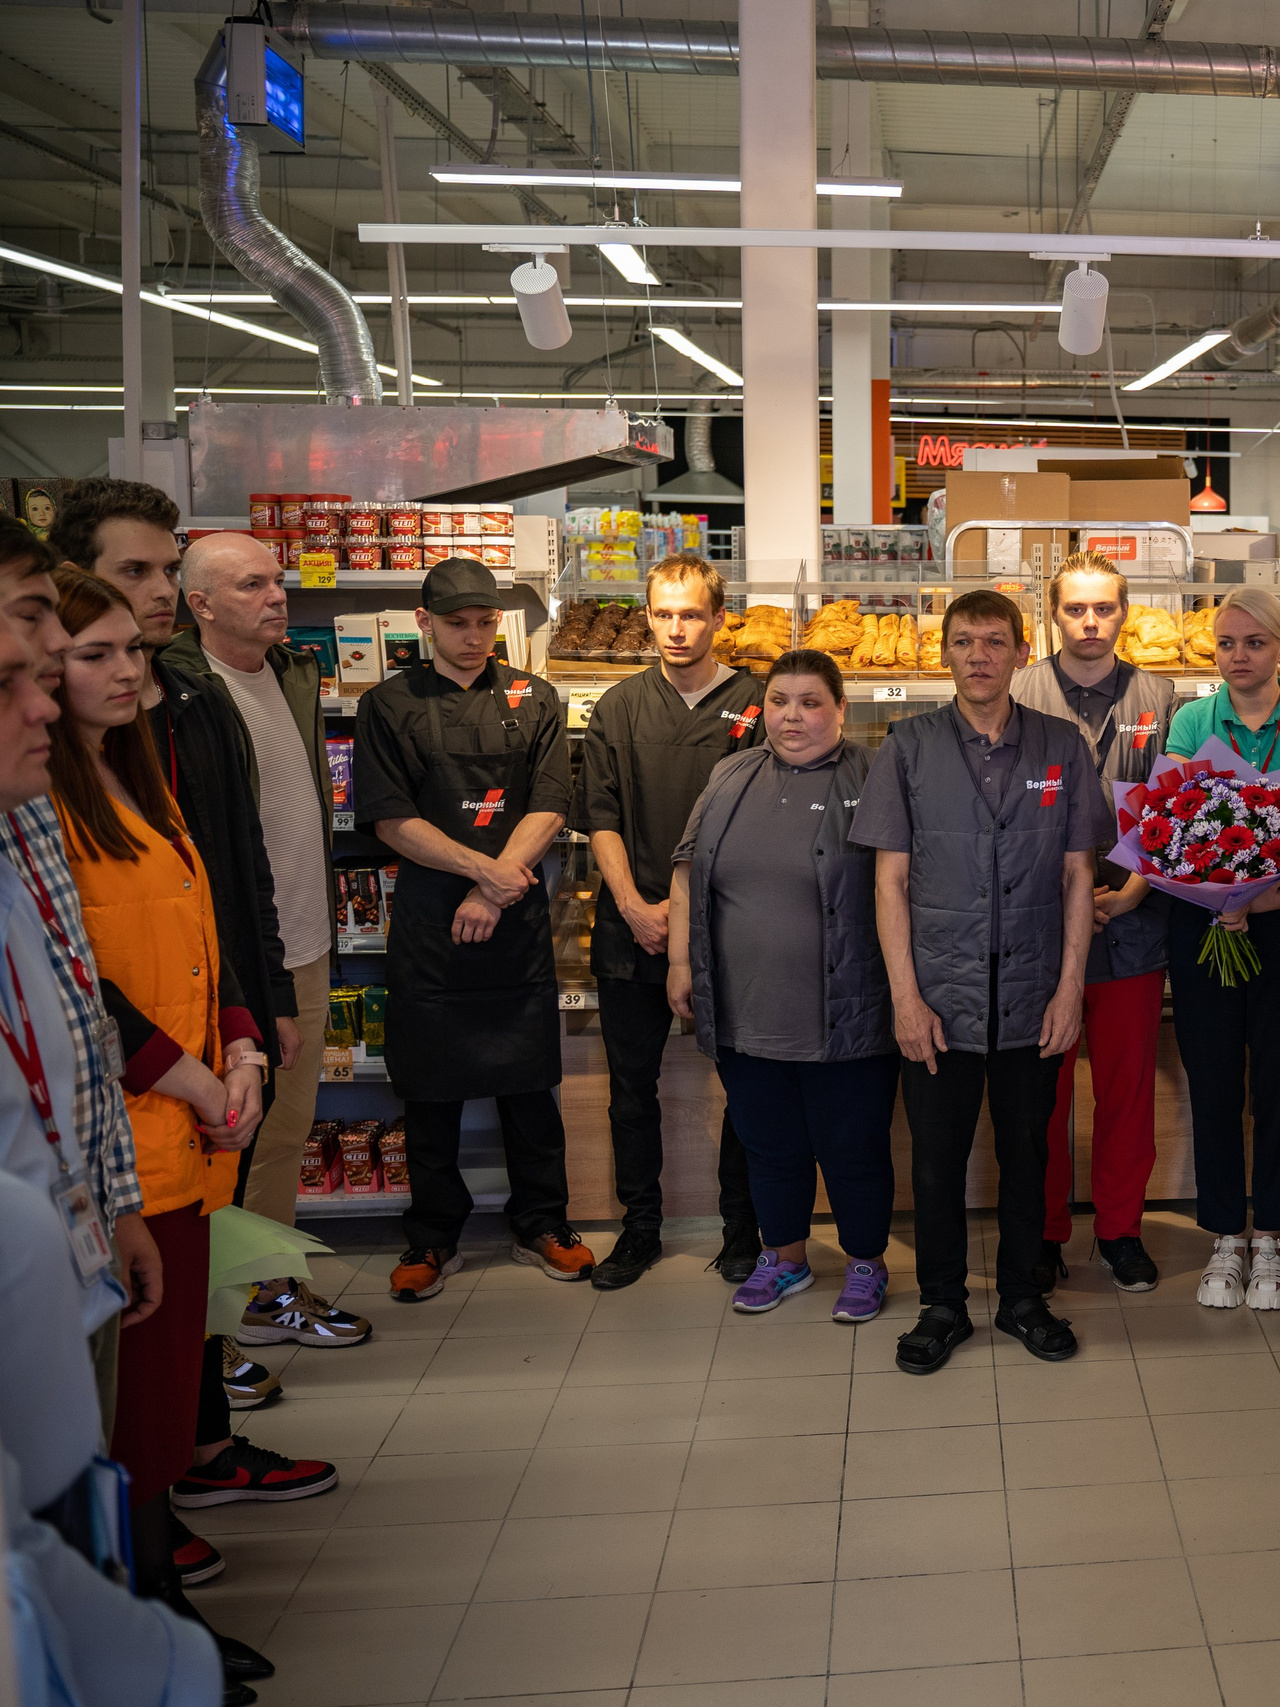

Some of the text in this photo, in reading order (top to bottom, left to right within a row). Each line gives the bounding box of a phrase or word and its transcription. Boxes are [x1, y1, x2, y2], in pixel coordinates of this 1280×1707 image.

[1095, 543, 1130, 552] Верный
[887, 687, 902, 697] 32
[721, 710, 757, 725] Верный
[1119, 721, 1158, 733] Верный
[462, 799, 505, 811] Верный
[337, 818, 349, 826] 99
[565, 994, 581, 1005] 39
[333, 1067, 349, 1077] 65
[382, 1154, 406, 1162] СТЕП
